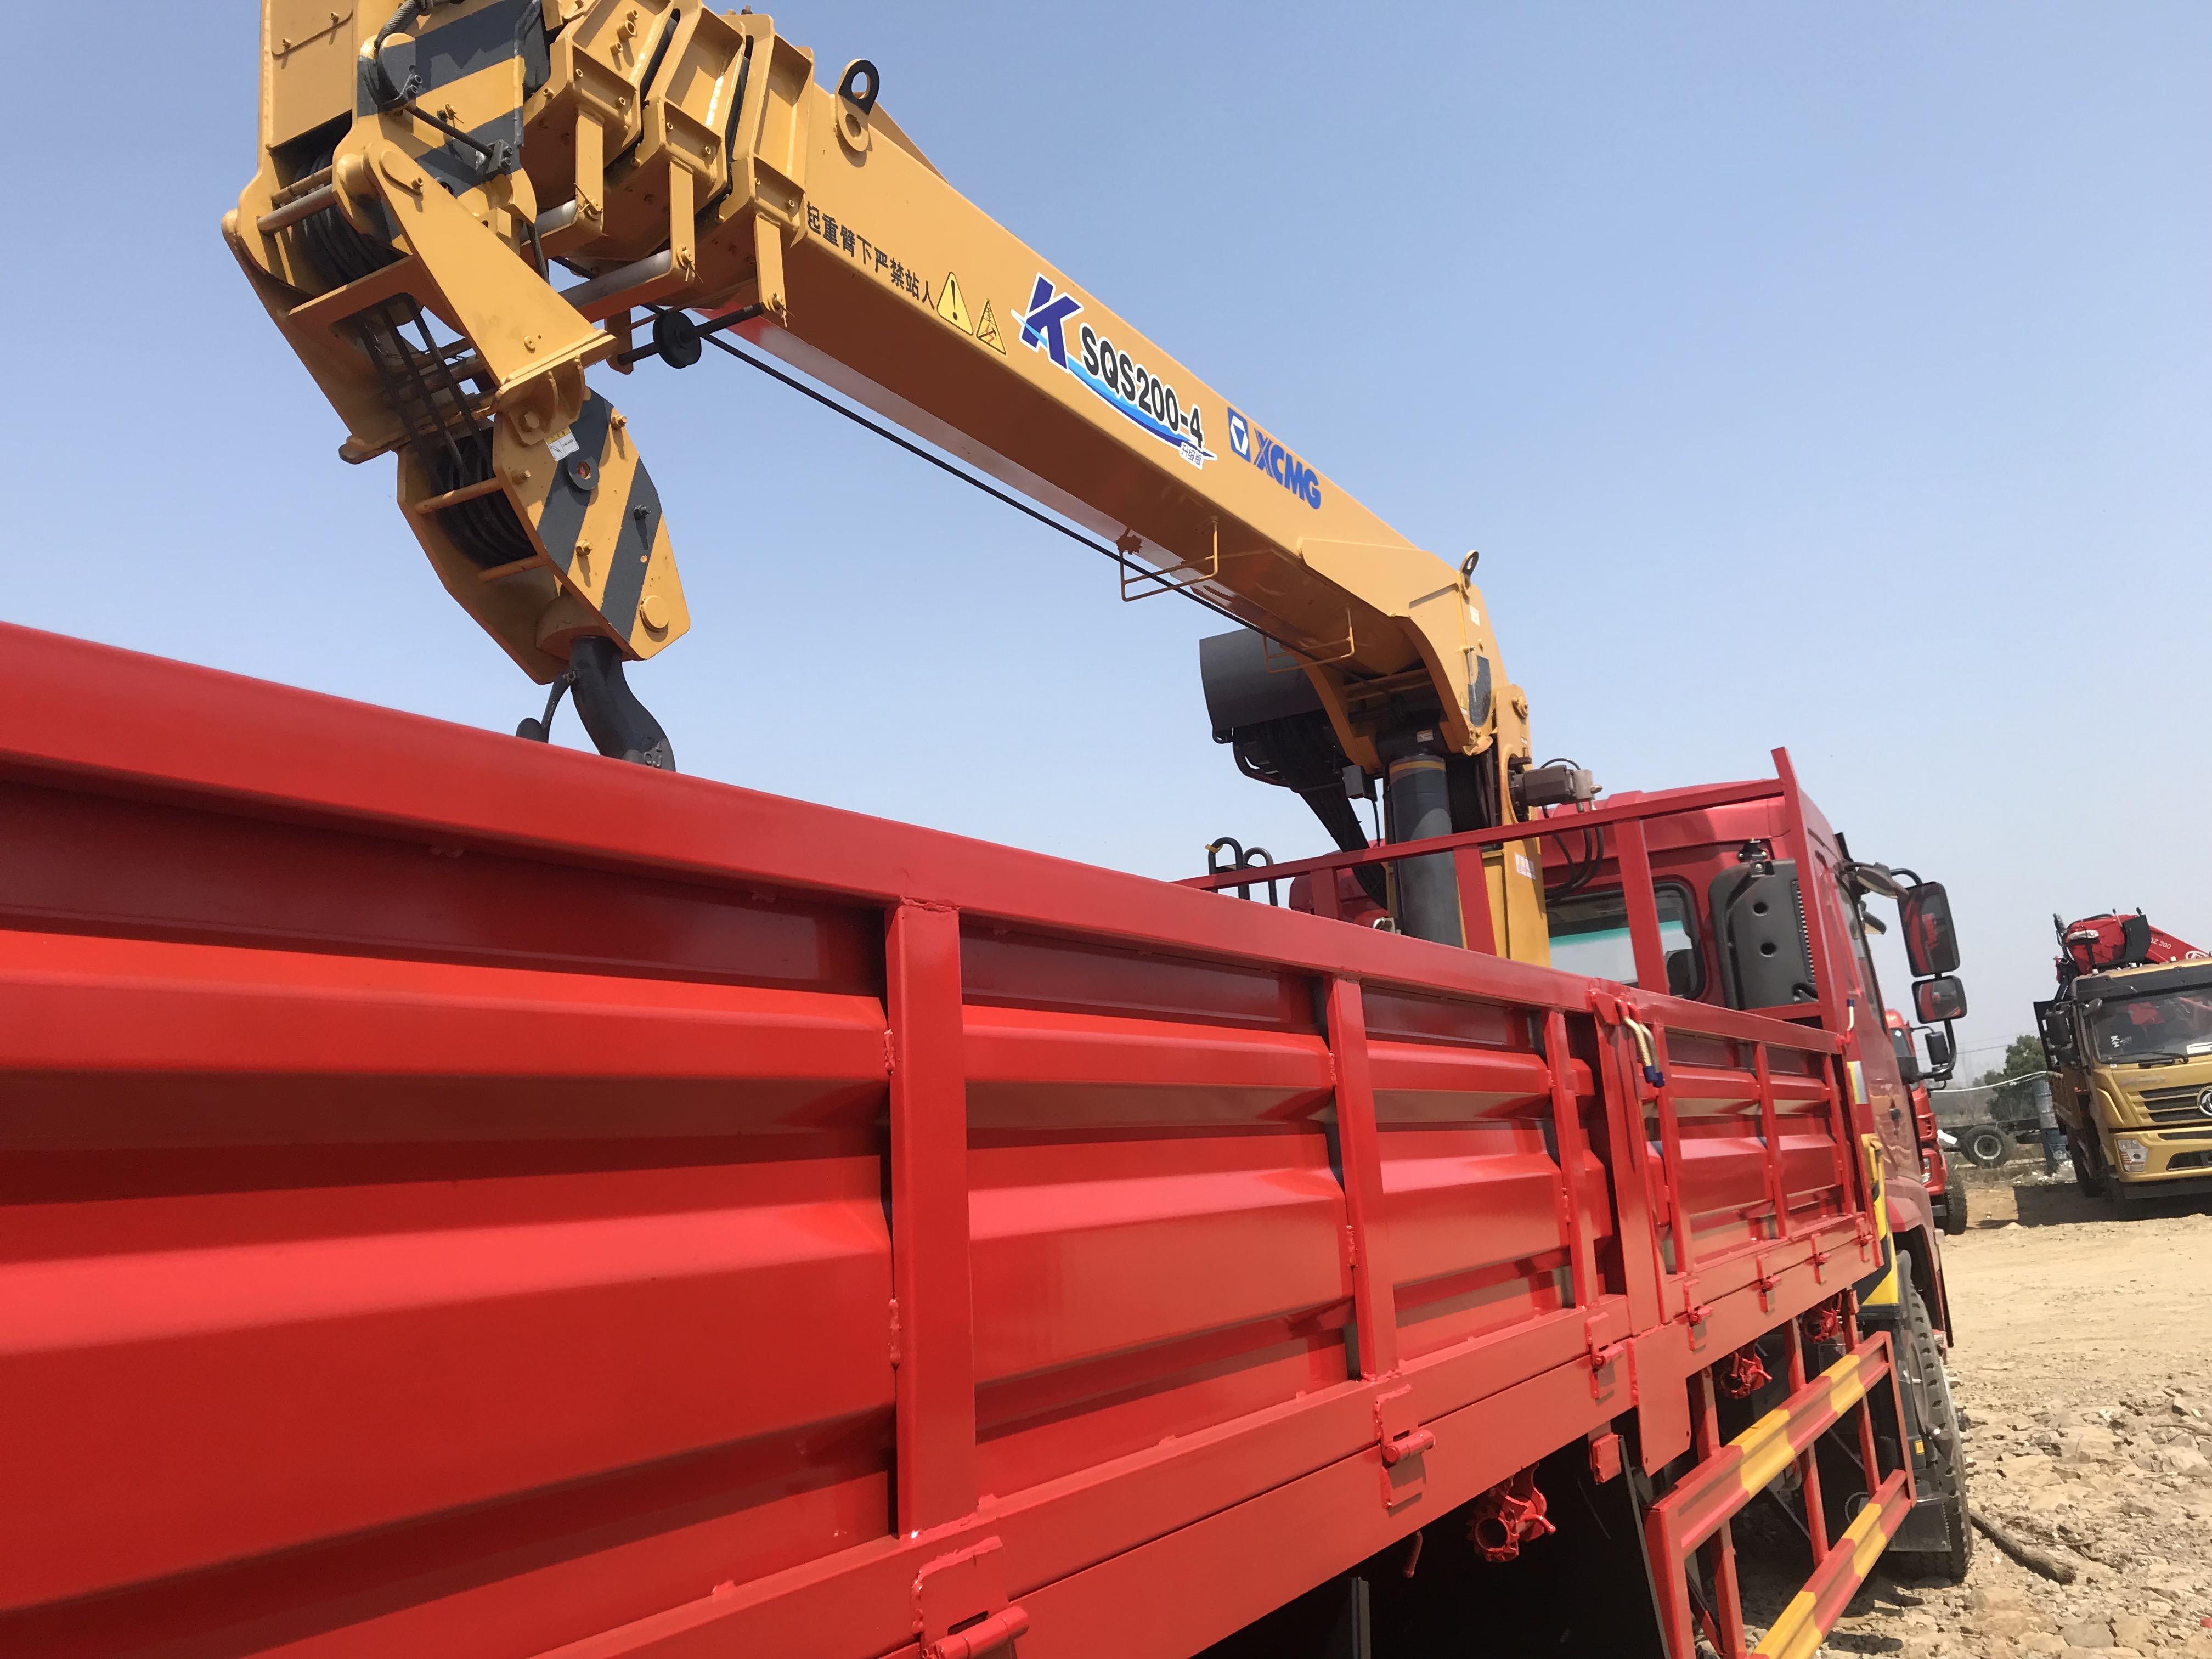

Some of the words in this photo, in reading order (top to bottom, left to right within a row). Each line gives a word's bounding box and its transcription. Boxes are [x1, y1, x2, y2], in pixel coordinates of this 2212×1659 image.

[806, 200, 935, 310] 起重臂下严禁站人
[1020, 274, 1082, 371] K
[1080, 325, 1203, 449] SQS200-4
[1253, 427, 1321, 510] XCMG
[2158, 941, 2171, 949] 200
